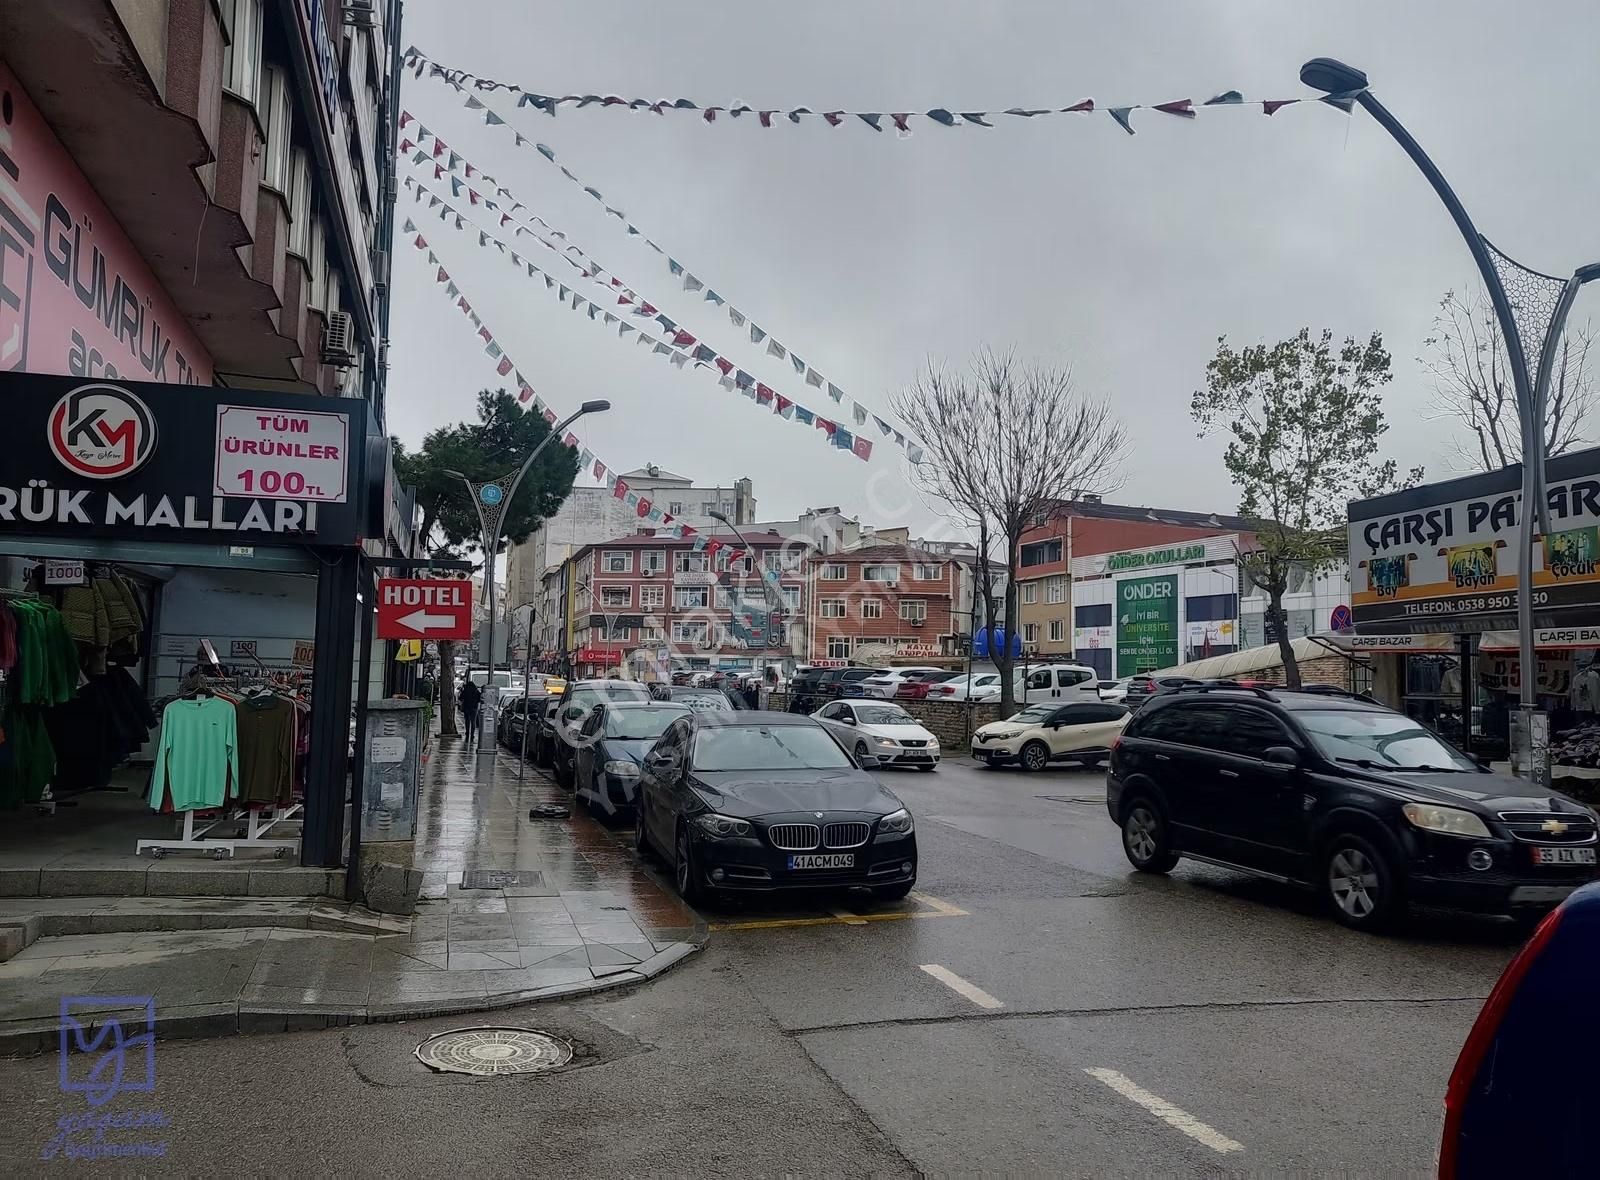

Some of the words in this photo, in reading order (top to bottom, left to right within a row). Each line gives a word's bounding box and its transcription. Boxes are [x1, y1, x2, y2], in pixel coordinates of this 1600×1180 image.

[44, 192, 171, 382] GÜMRÜK
[256, 414, 309, 434] TÜM
[224, 436, 340, 460] ÜRÜNLER
[105, 492, 318, 533] MALLARI
[1364, 507, 1453, 556] ÇARŞI
[1467, 480, 1600, 534] PAAR
[1146, 545, 1205, 565] OKULLARI
[47, 567, 83, 579] 1000
[1377, 585, 1398, 599] Bay
[1455, 573, 1495, 590] Bayan
[1551, 560, 1597, 582] Çocuk
[384, 585, 466, 606] HOTEL
[1404, 600, 1456, 616] TELEFON:
[1458, 598, 1486, 612] 0538
[1488, 596, 1511, 609] 950
[1351, 637, 1379, 648] ÇARŞI
[1379, 636, 1412, 646] BAZAR
[1539, 630, 1577, 645] ÇARŞI
